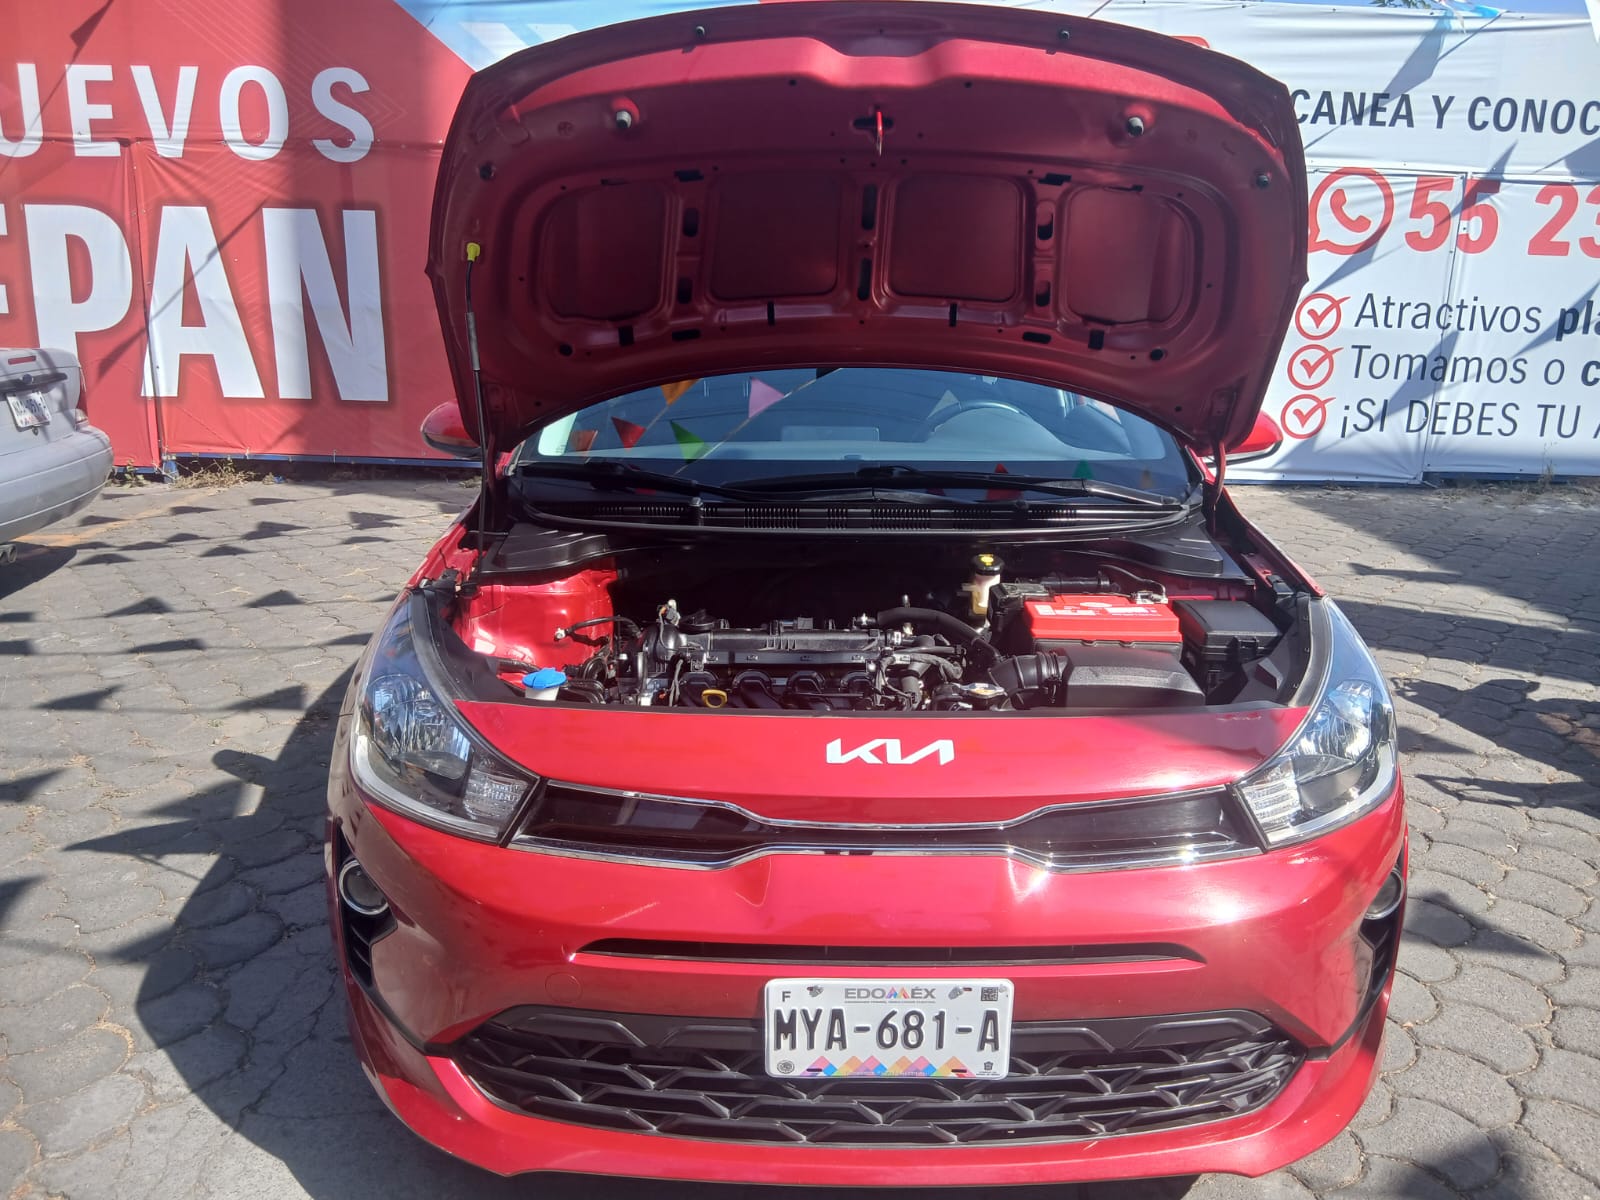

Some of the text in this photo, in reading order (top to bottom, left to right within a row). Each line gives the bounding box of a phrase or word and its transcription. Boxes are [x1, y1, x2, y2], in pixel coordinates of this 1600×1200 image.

[0, 63, 375, 163] UEVOS
[1432, 95, 1455, 129] Y
[1467, 96, 1600, 136] CONOC
[1404, 176, 1500, 255] 55
[0, 203, 389, 402] PAN
[1354, 293, 1542, 334] Atractivos
[1351, 345, 1528, 385] Tomamos
[1544, 359, 1565, 386] o
[1341, 398, 1388, 438] ¡SI
[1405, 400, 1520, 437] DEBES
[1537, 404, 1581, 439] TU
[774, 1008, 1000, 1051] MYA-681-A
